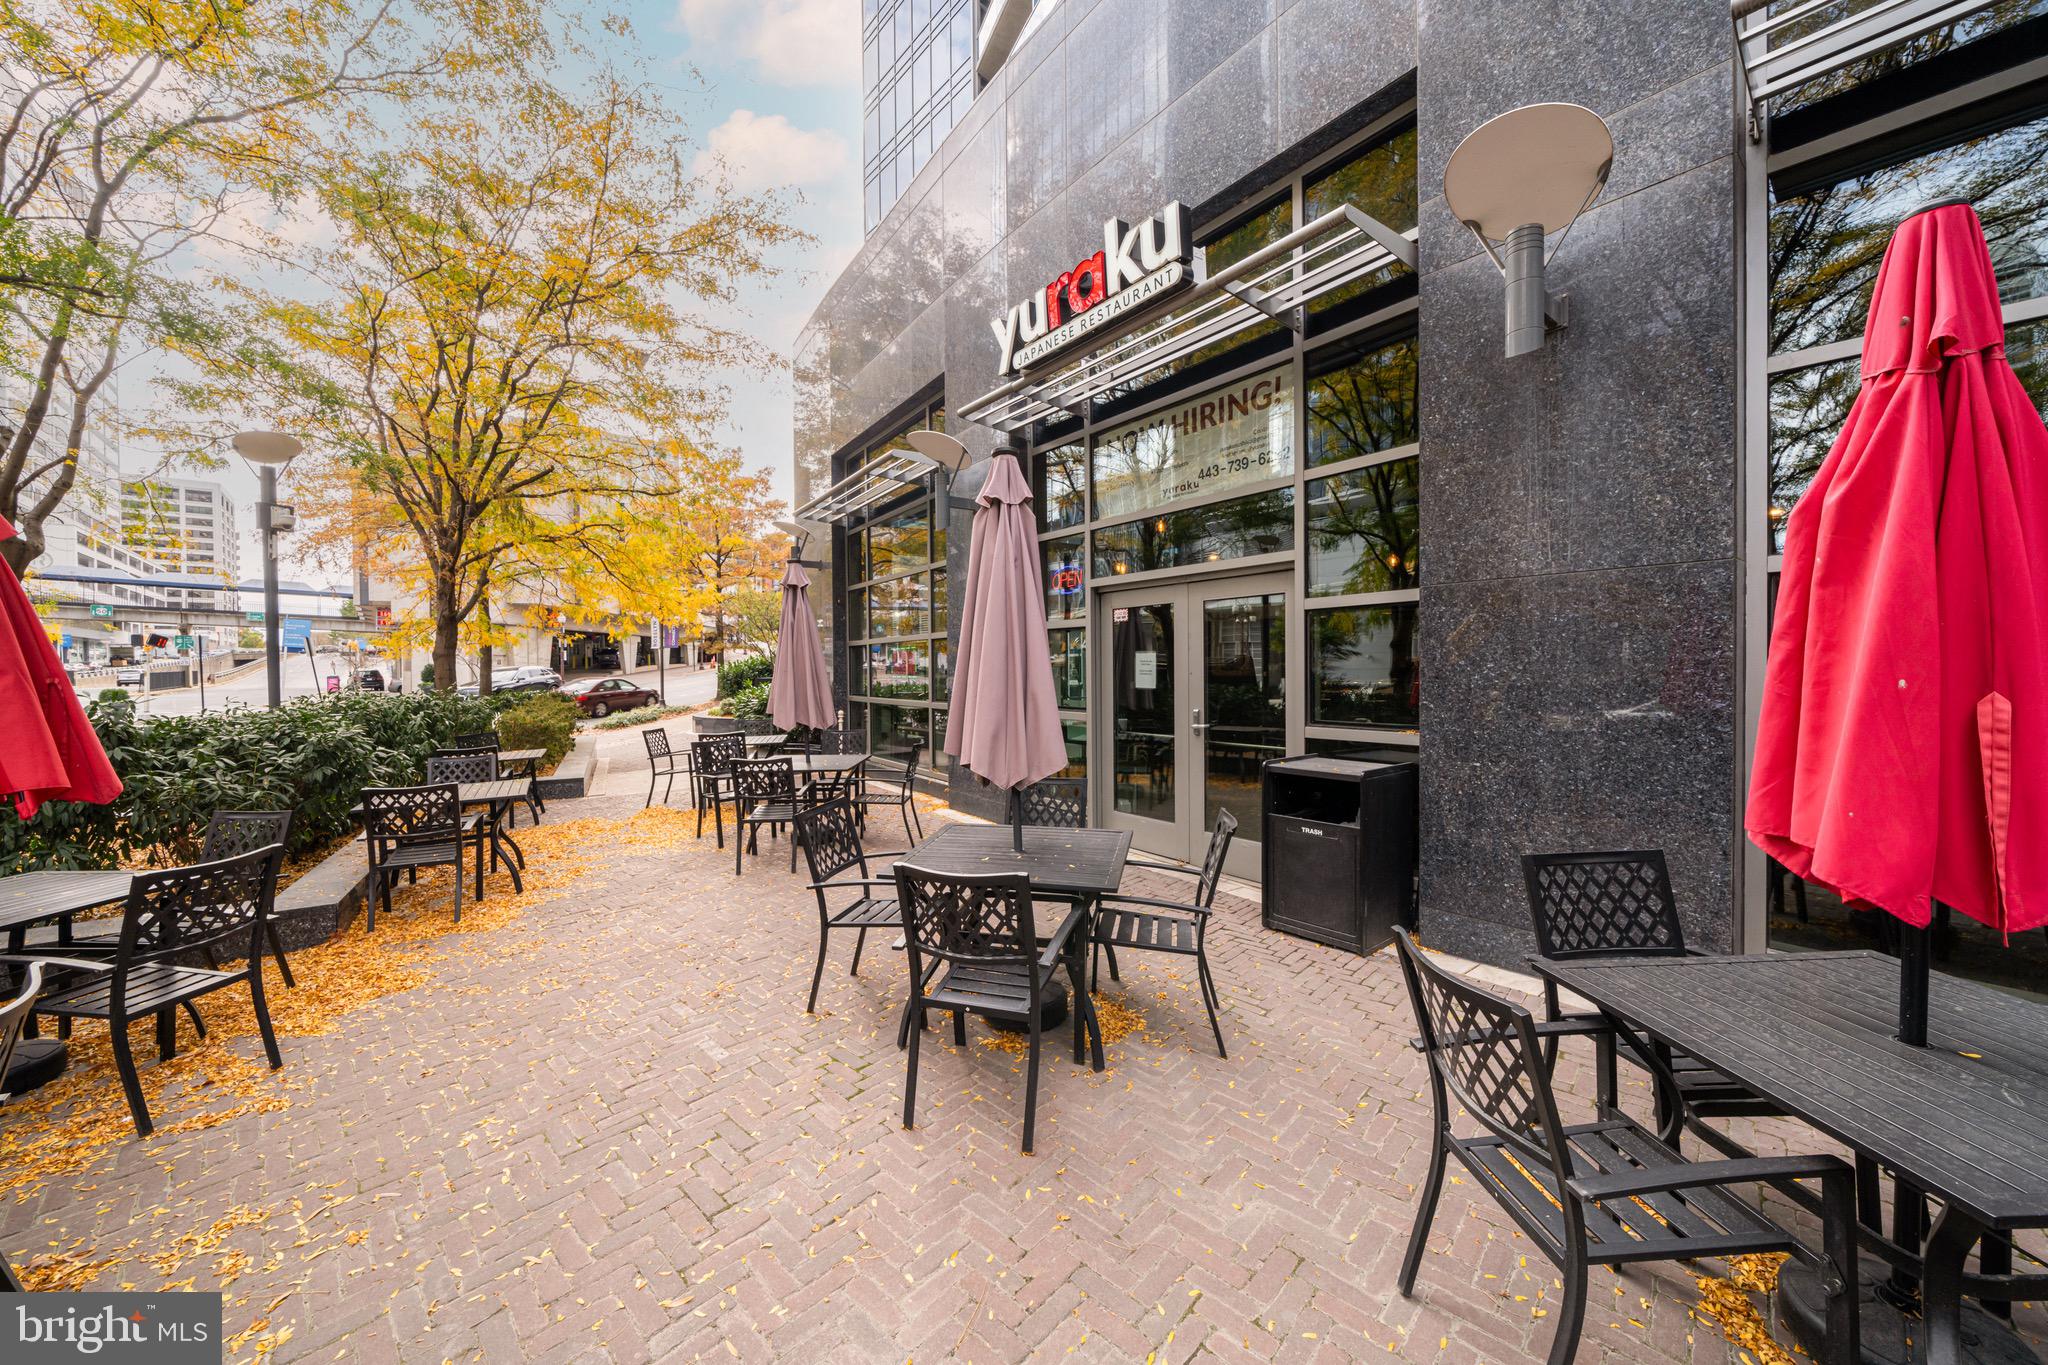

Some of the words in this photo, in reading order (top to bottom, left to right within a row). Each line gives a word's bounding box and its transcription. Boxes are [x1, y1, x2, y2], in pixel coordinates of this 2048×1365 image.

[991, 200, 1190, 376] yuraku
[1018, 326, 1075, 366] JAPANESE
[1081, 268, 1174, 329] RESTAURANT
[1172, 376, 1283, 437] HIRING!
[1163, 481, 1200, 499] yuraku
[1051, 569, 1083, 591] OPEN
[1301, 826, 1323, 836] TRASH
